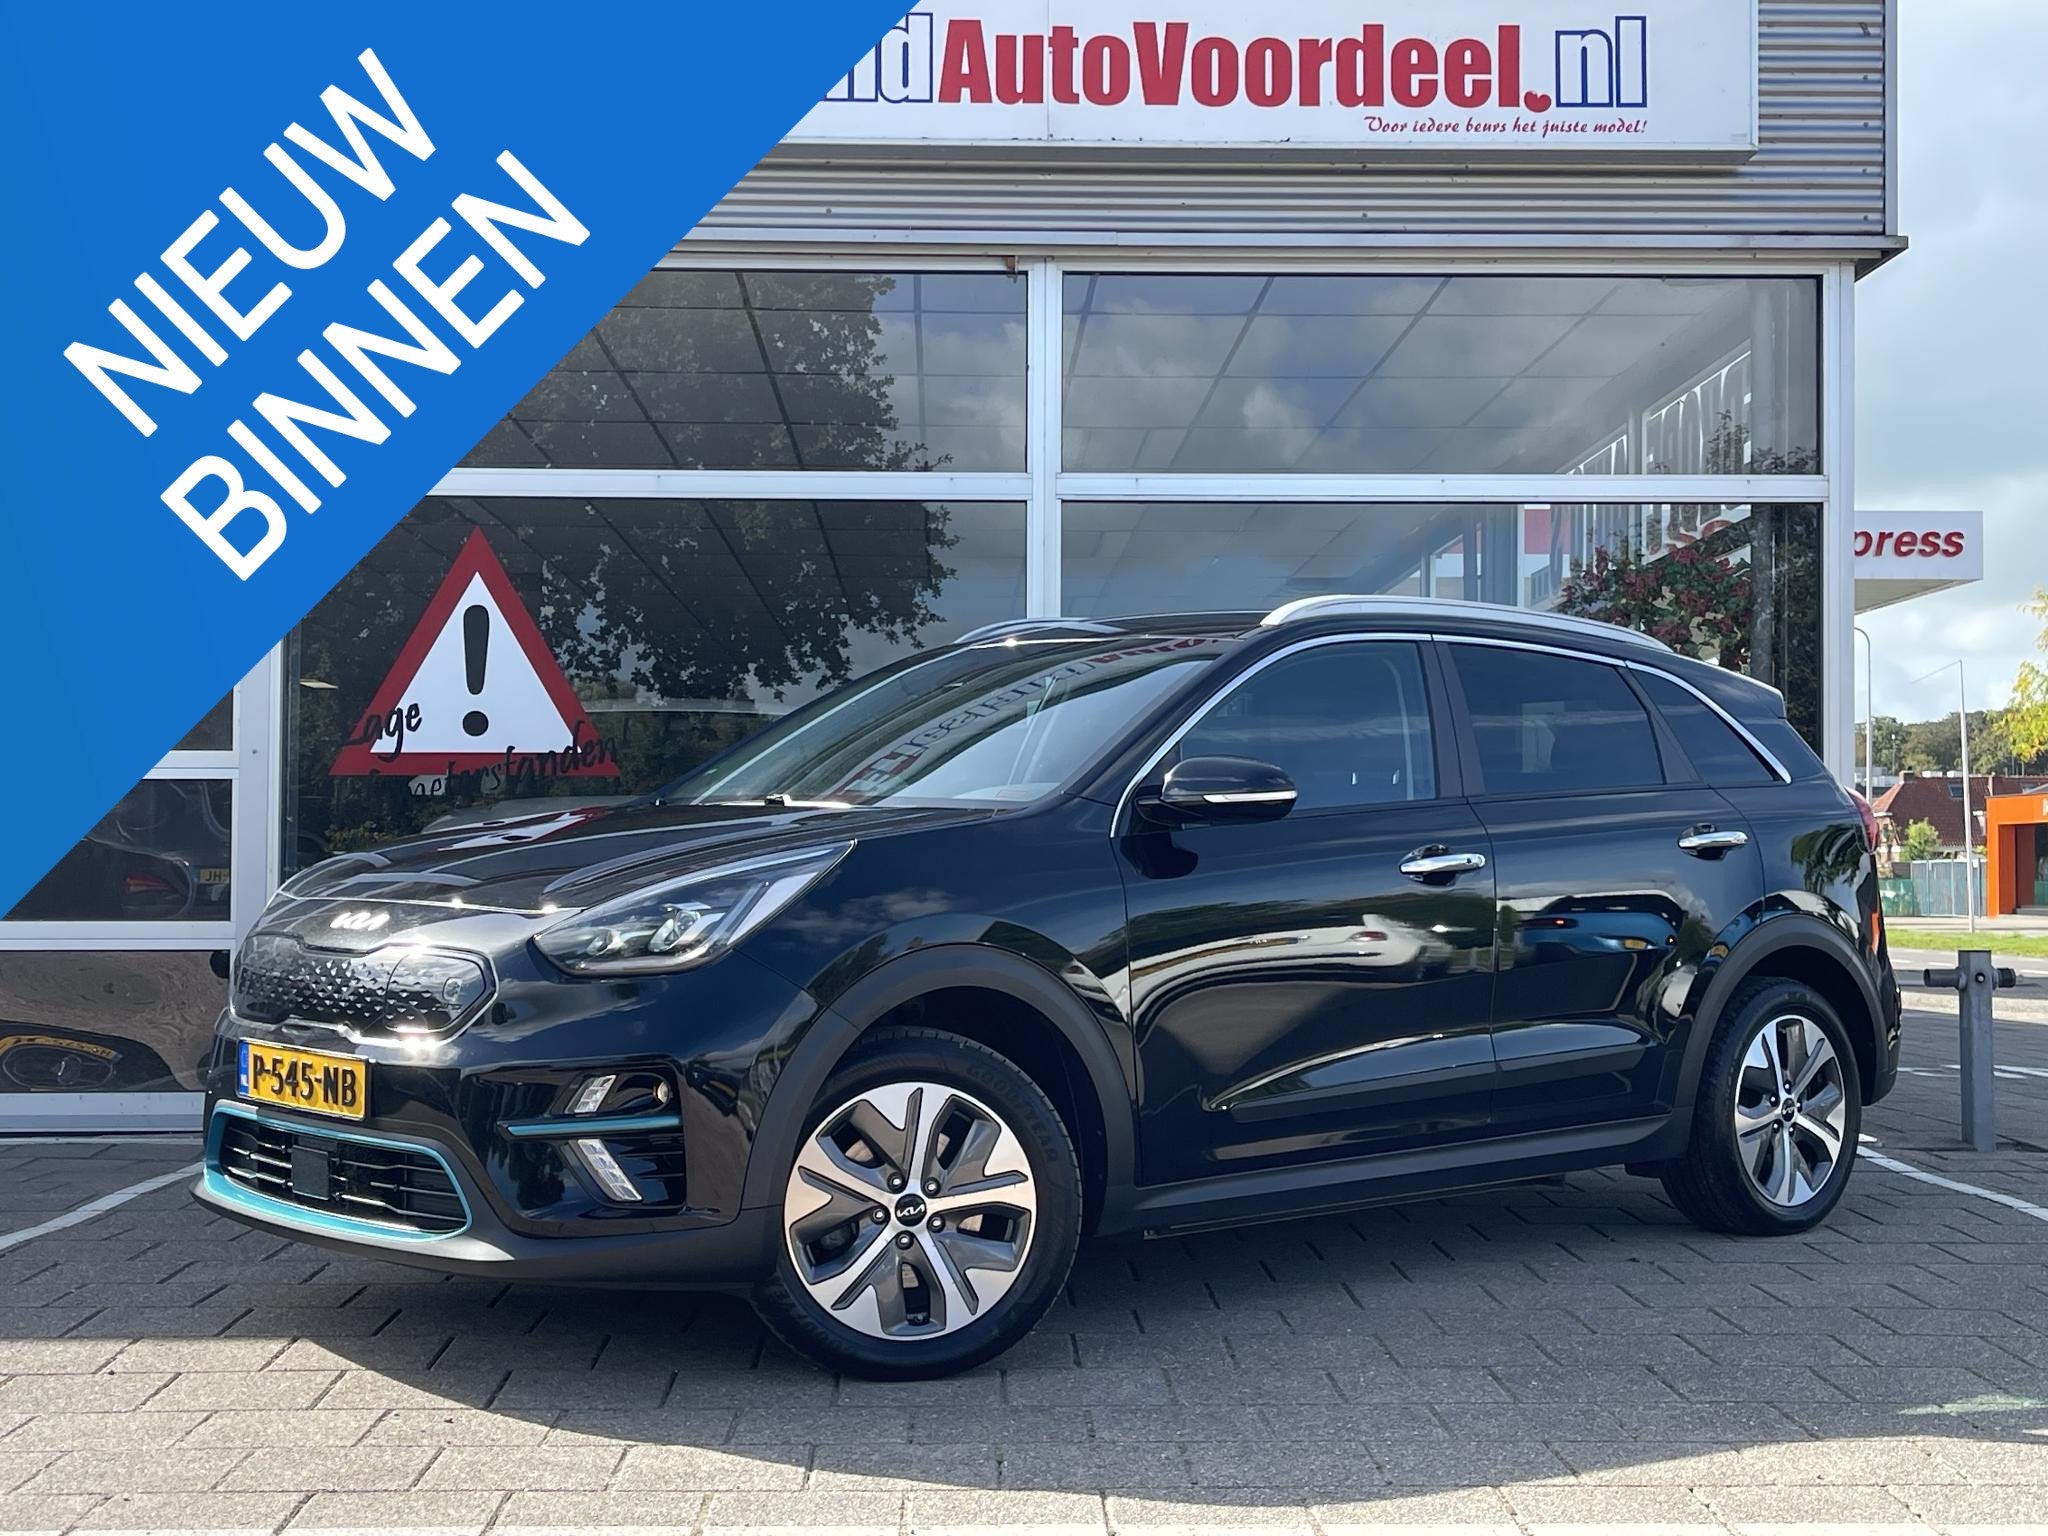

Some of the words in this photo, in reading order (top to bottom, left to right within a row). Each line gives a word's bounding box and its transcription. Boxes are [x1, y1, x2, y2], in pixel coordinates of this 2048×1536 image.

[1364, 116, 1408, 133] Voor
[1412, 116, 1460, 133] iedere
[1465, 116, 1507, 133] beurs
[1512, 116, 1537, 133] het
[1541, 117, 1588, 139] juiste
[1592, 117, 1648, 134] model!
[252, 1052, 357, 1108] P-545-NB
[895, 1203, 926, 1218] KIA
